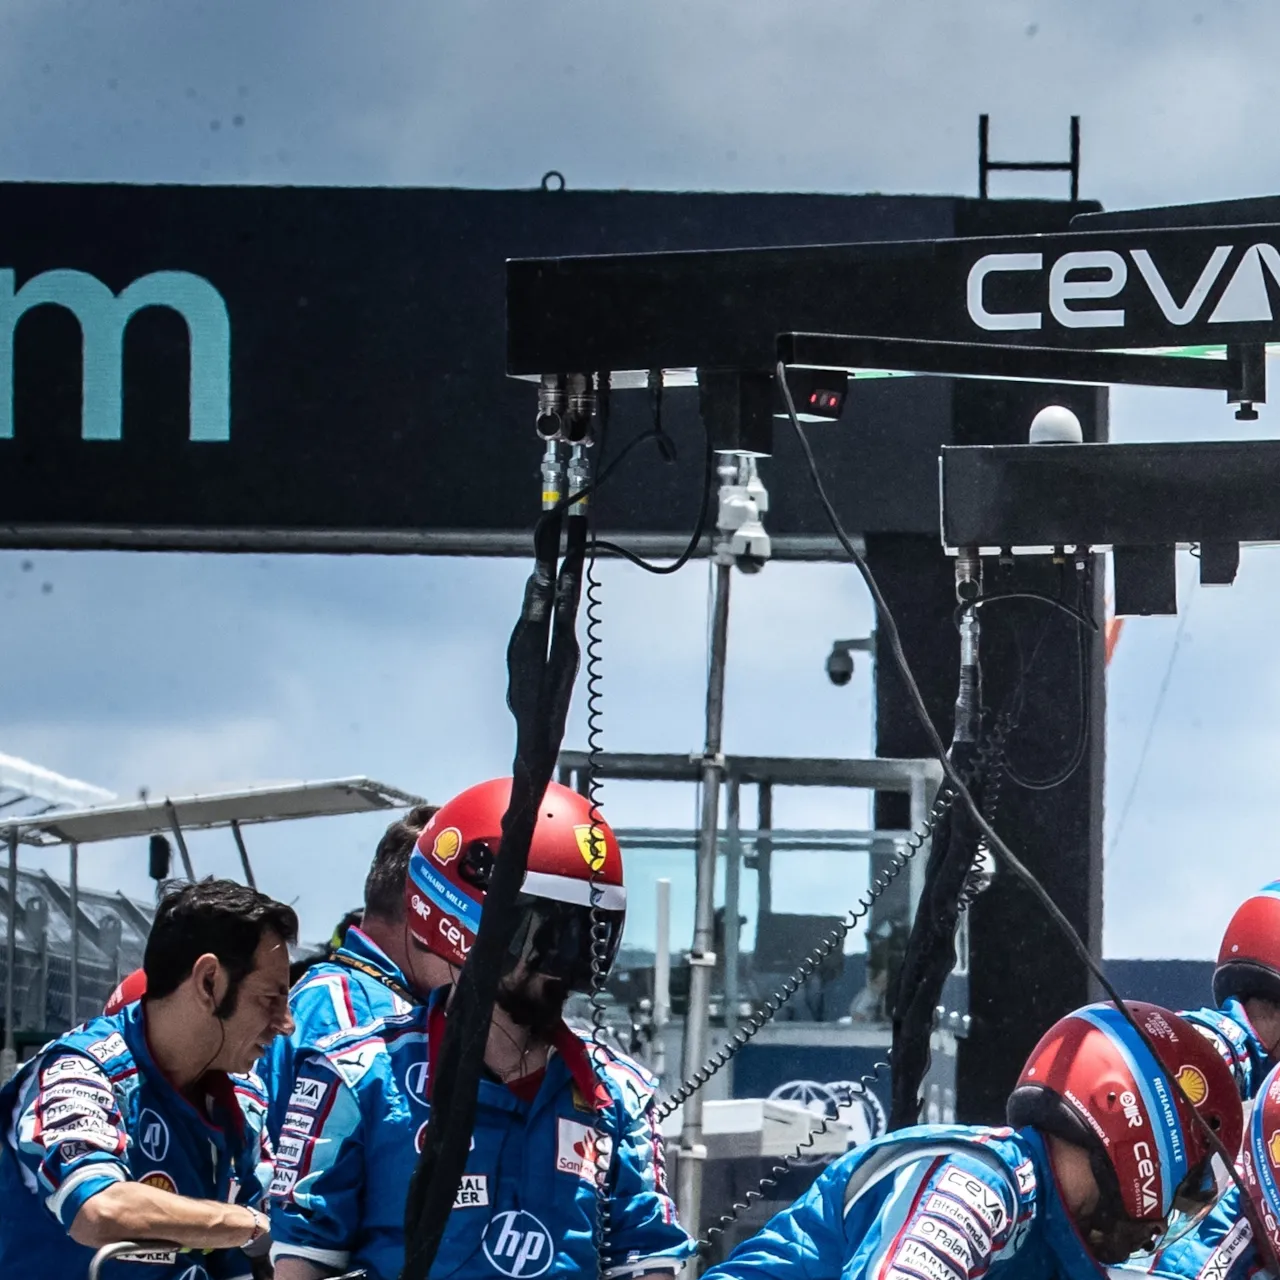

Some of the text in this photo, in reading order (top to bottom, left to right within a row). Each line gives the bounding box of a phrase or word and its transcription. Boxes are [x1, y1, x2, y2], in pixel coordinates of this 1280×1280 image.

[420, 865, 468, 913] RICHARD MILLE
[1150, 1012, 1179, 1044] PERONI
[1153, 1077, 1184, 1164] RICHARD MILLE
[1133, 1177, 1141, 1218] LOGISTICS
[488, 1211, 551, 1278] hp
[931, 1199, 988, 1252] Bitdefender
[934, 1228, 971, 1269] Palan
